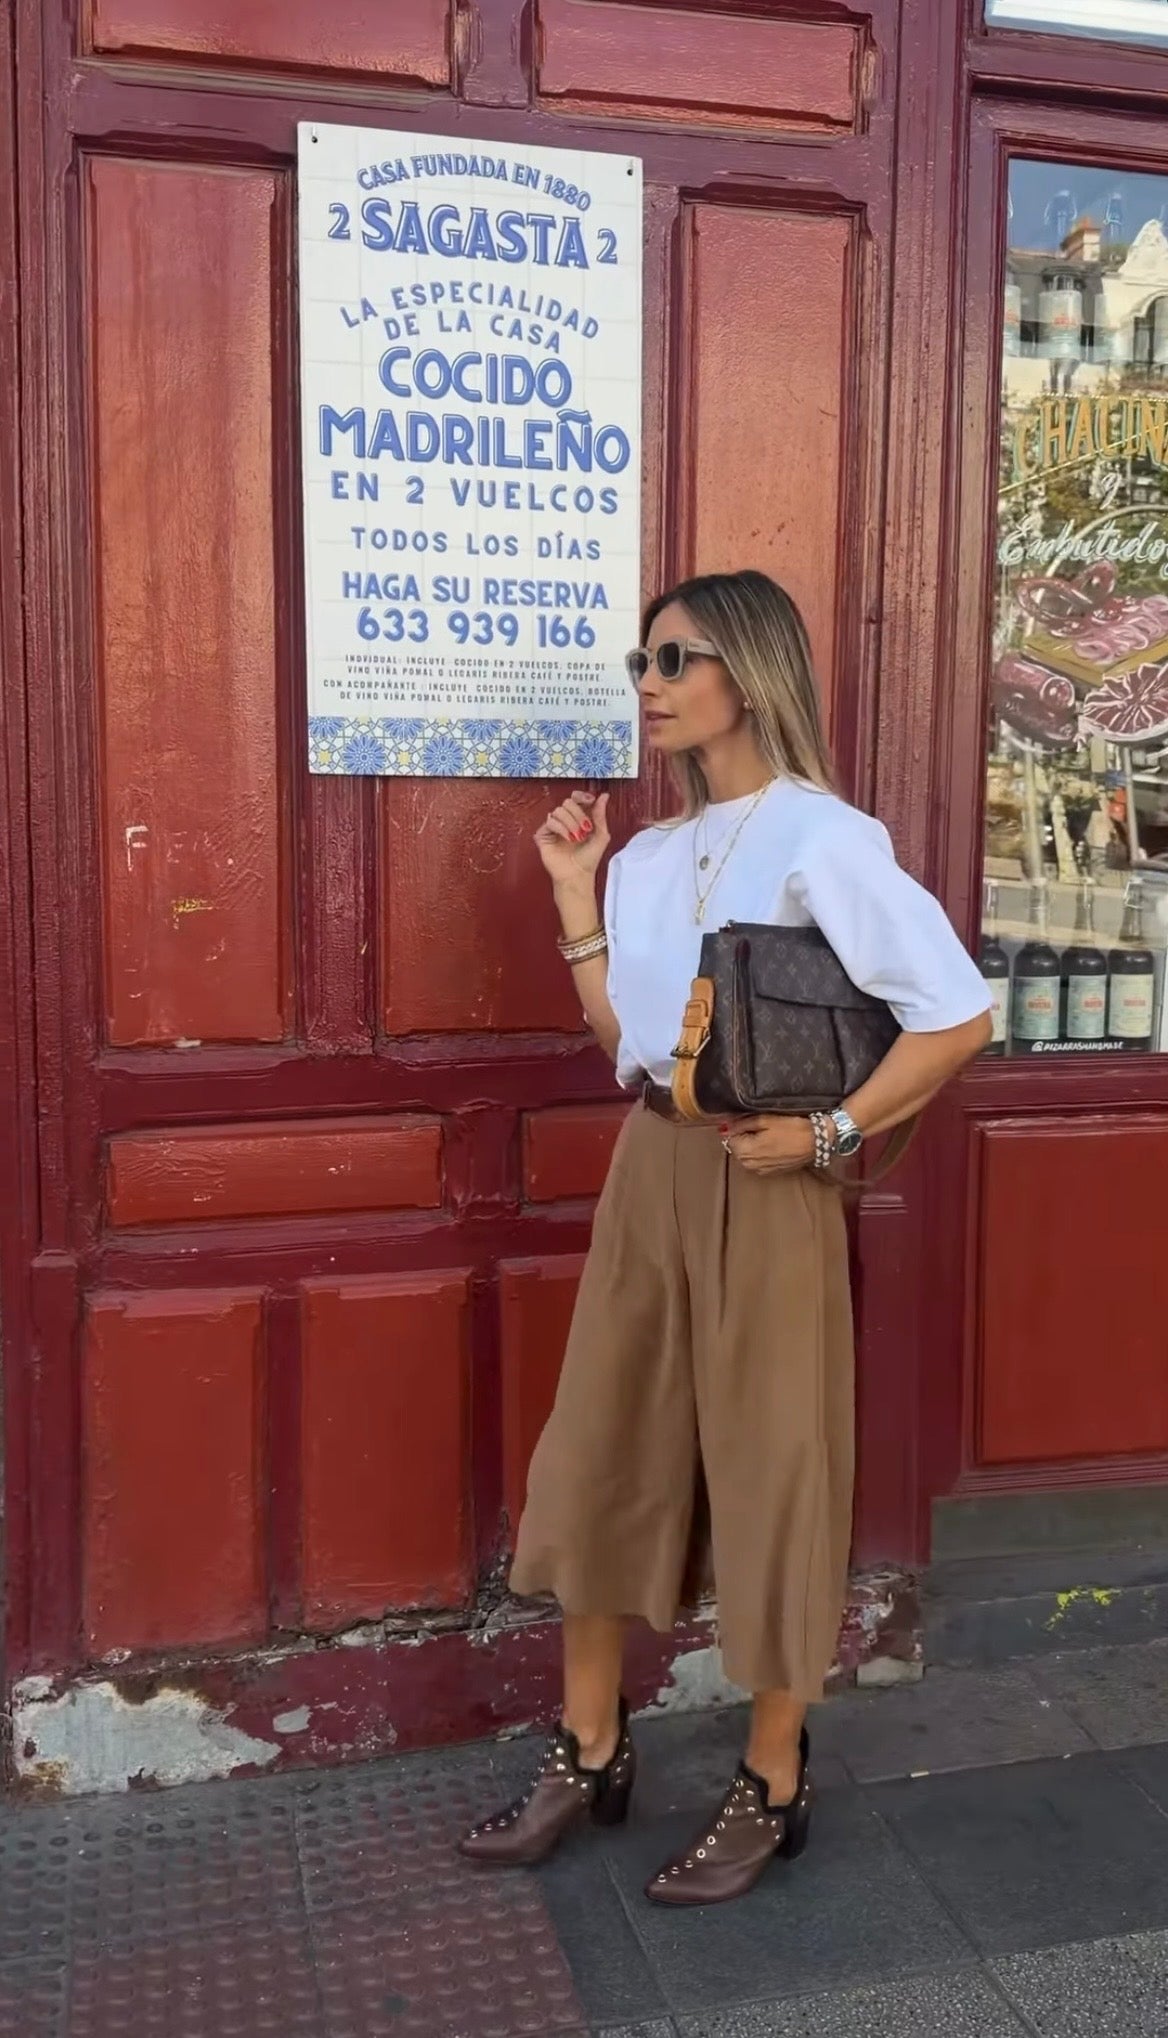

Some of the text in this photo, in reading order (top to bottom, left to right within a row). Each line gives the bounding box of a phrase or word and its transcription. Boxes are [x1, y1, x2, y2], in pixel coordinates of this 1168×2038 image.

[356, 153, 592, 213] CASA FUNDADA EN 1880
[327, 196, 619, 270] 2 SAGASTA 2
[340, 280, 600, 340] LA ESPECIALIDAD
[383, 309, 561, 354] DE LA CASA
[378, 346, 573, 408] COCIDO
[318, 404, 631, 475] MADRILEÑO
[1013, 397, 1168, 484] CHACIN
[330, 470, 619, 515] EN 2 VUELCOS
[351, 526, 601, 561] TODOS LOS DÍAS
[341, 570, 609, 611] HAGA SU RESERVA
[356, 606, 596, 649] 633 939 166
[348, 665, 370, 674] VINO
[402, 667, 433, 677] POMAL
[492, 671, 526, 680] RIBERA
[406, 656, 445, 666] INCLUYE
[454, 658, 489, 668] COCIDO
[494, 660, 504, 669] EN
[567, 662, 590, 671] COPA
[595, 662, 606, 672] DE
[323, 679, 342, 688] CON
[347, 680, 416, 691] ACOMPAÑANTE
[428, 683, 467, 693] INCLUYE
[476, 684, 511, 694] COCIDO
[516, 686, 526, 694] EN
[588, 687, 626, 697] BOTELLA
[340, 691, 351, 700] DE
[356, 691, 379, 701] VINO
[411, 693, 442, 703] POMAL
[500, 696, 534, 706] RIBERA
